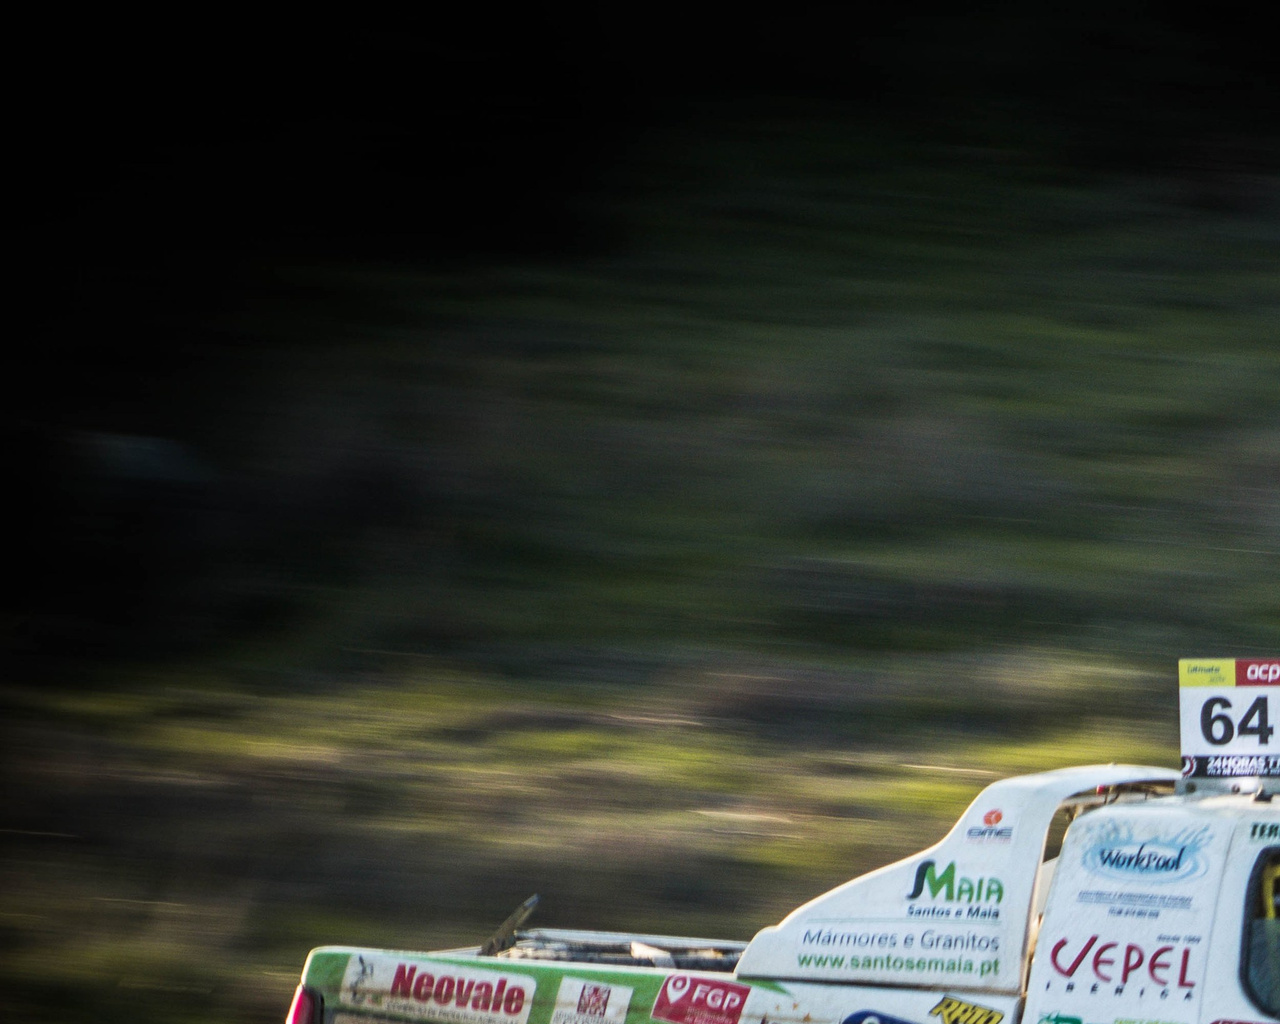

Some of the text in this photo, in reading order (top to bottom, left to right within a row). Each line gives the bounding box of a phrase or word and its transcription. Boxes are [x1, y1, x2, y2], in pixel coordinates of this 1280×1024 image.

[1246, 664, 1280, 682] acp
[1200, 695, 1274, 746] 64
[907, 905, 1000, 920] Santos e Maia
[802, 928, 1000, 952] Mármores e Granitos
[798, 953, 1001, 978] www.santosemaia.pt
[1050, 934, 1197, 988] VEPEL
[391, 963, 525, 1017] Neovale
[692, 984, 741, 1011] FGP
